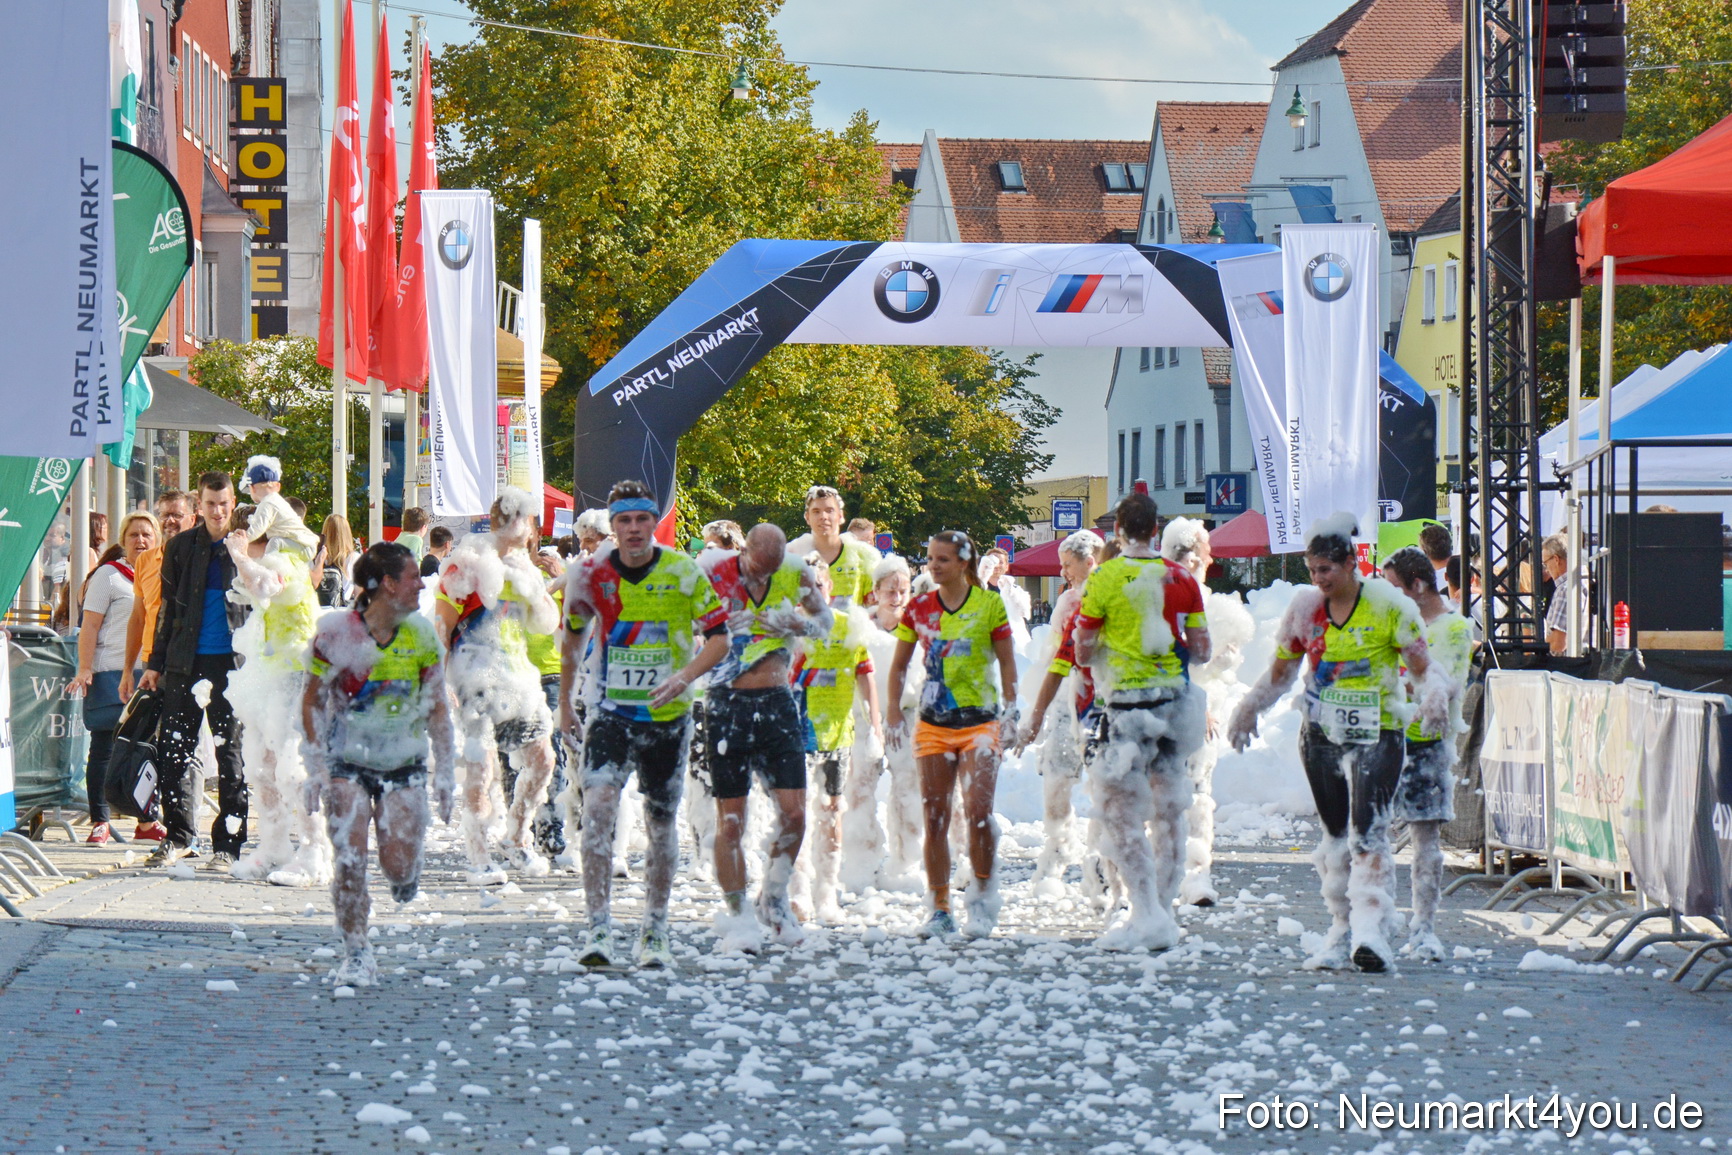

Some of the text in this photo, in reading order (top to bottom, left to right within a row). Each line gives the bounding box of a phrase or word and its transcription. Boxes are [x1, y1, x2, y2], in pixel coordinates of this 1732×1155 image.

[880, 260, 935, 281] BMW
[70, 157, 99, 437] PARTL NEUMARKT
[612, 307, 760, 406] PARTL NEUMARKT
[1435, 354, 1457, 381] HOTEL
[613, 650, 666, 663] BOCK
[622, 669, 658, 686] 172
